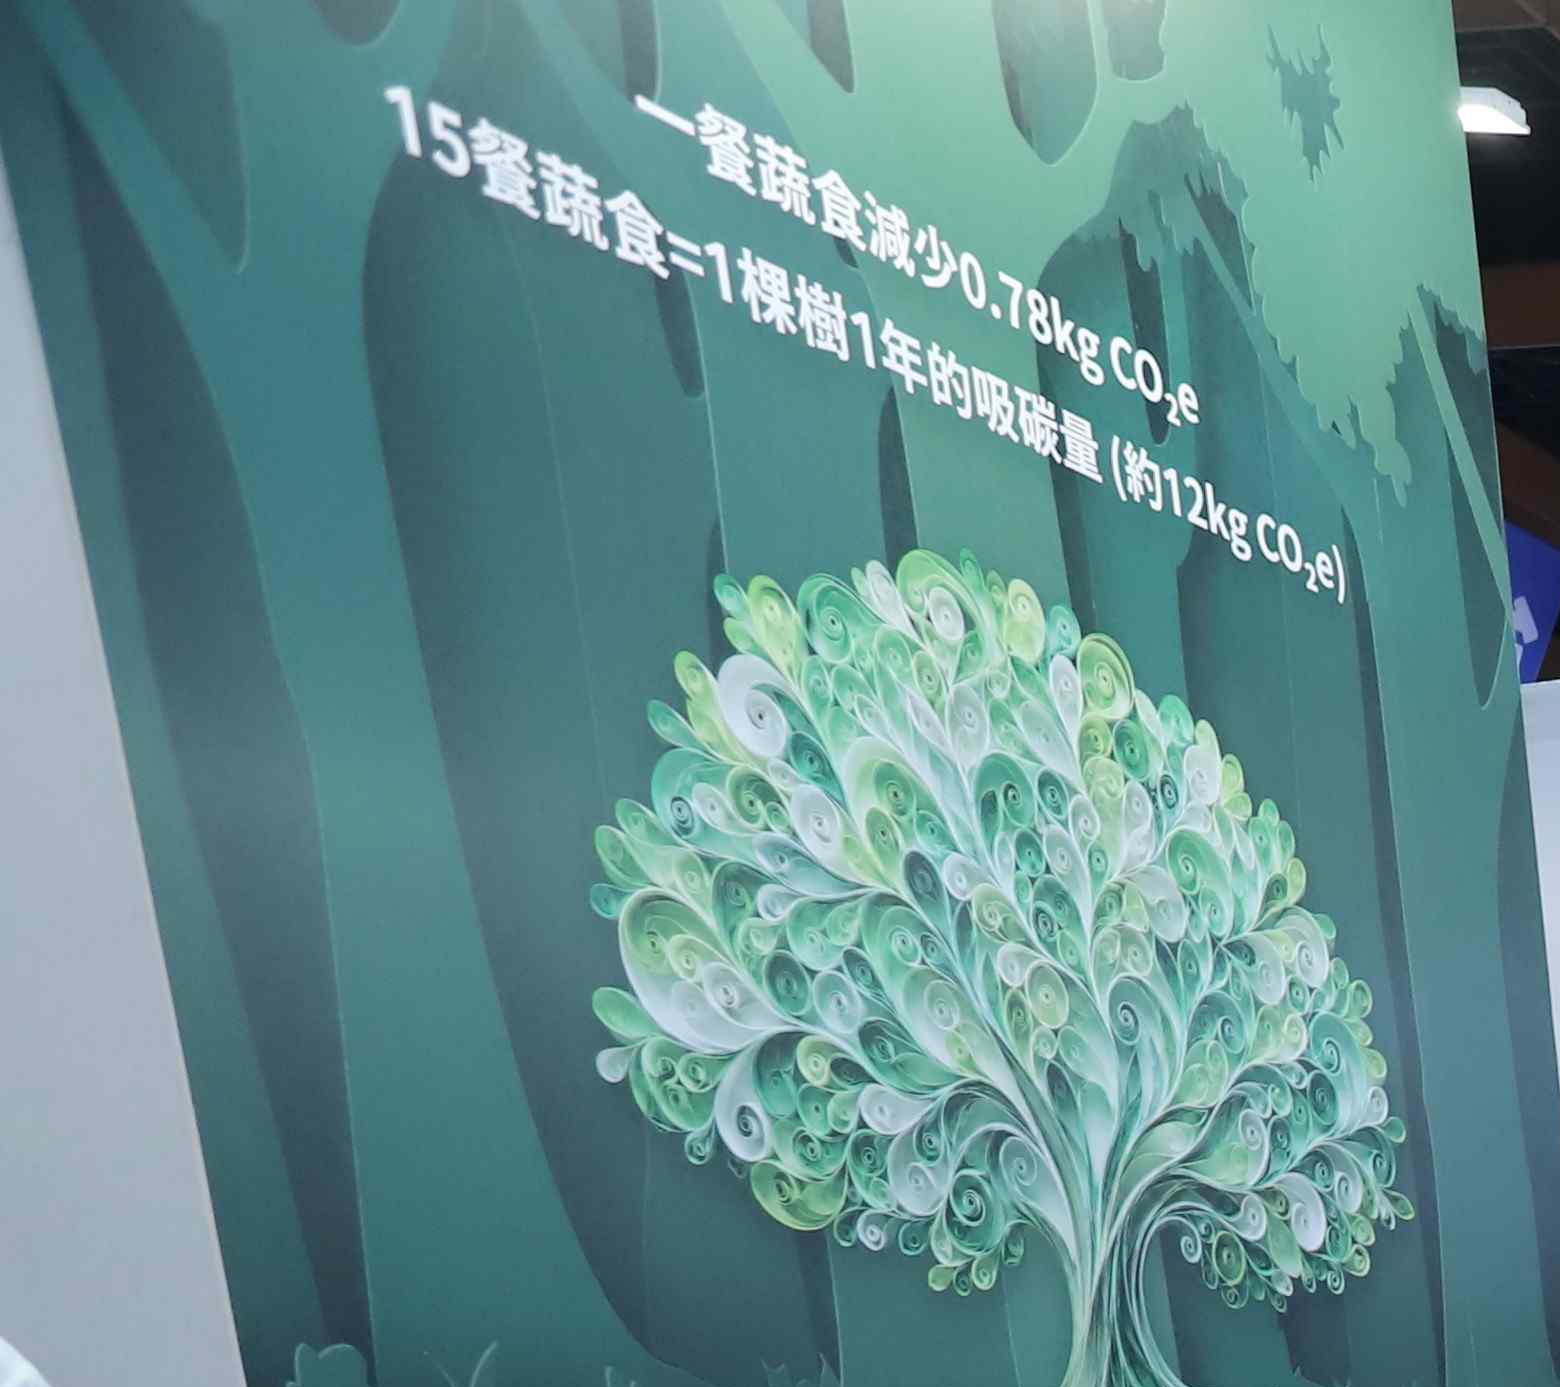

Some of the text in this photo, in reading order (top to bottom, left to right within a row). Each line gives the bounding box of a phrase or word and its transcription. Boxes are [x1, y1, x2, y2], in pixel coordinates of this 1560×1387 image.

[384, 85, 1103, 484] 15餐蔬食=1棵樹1年的吸碳量
[634, 93, 1105, 387] 一餐蔬食減少0.78kg
